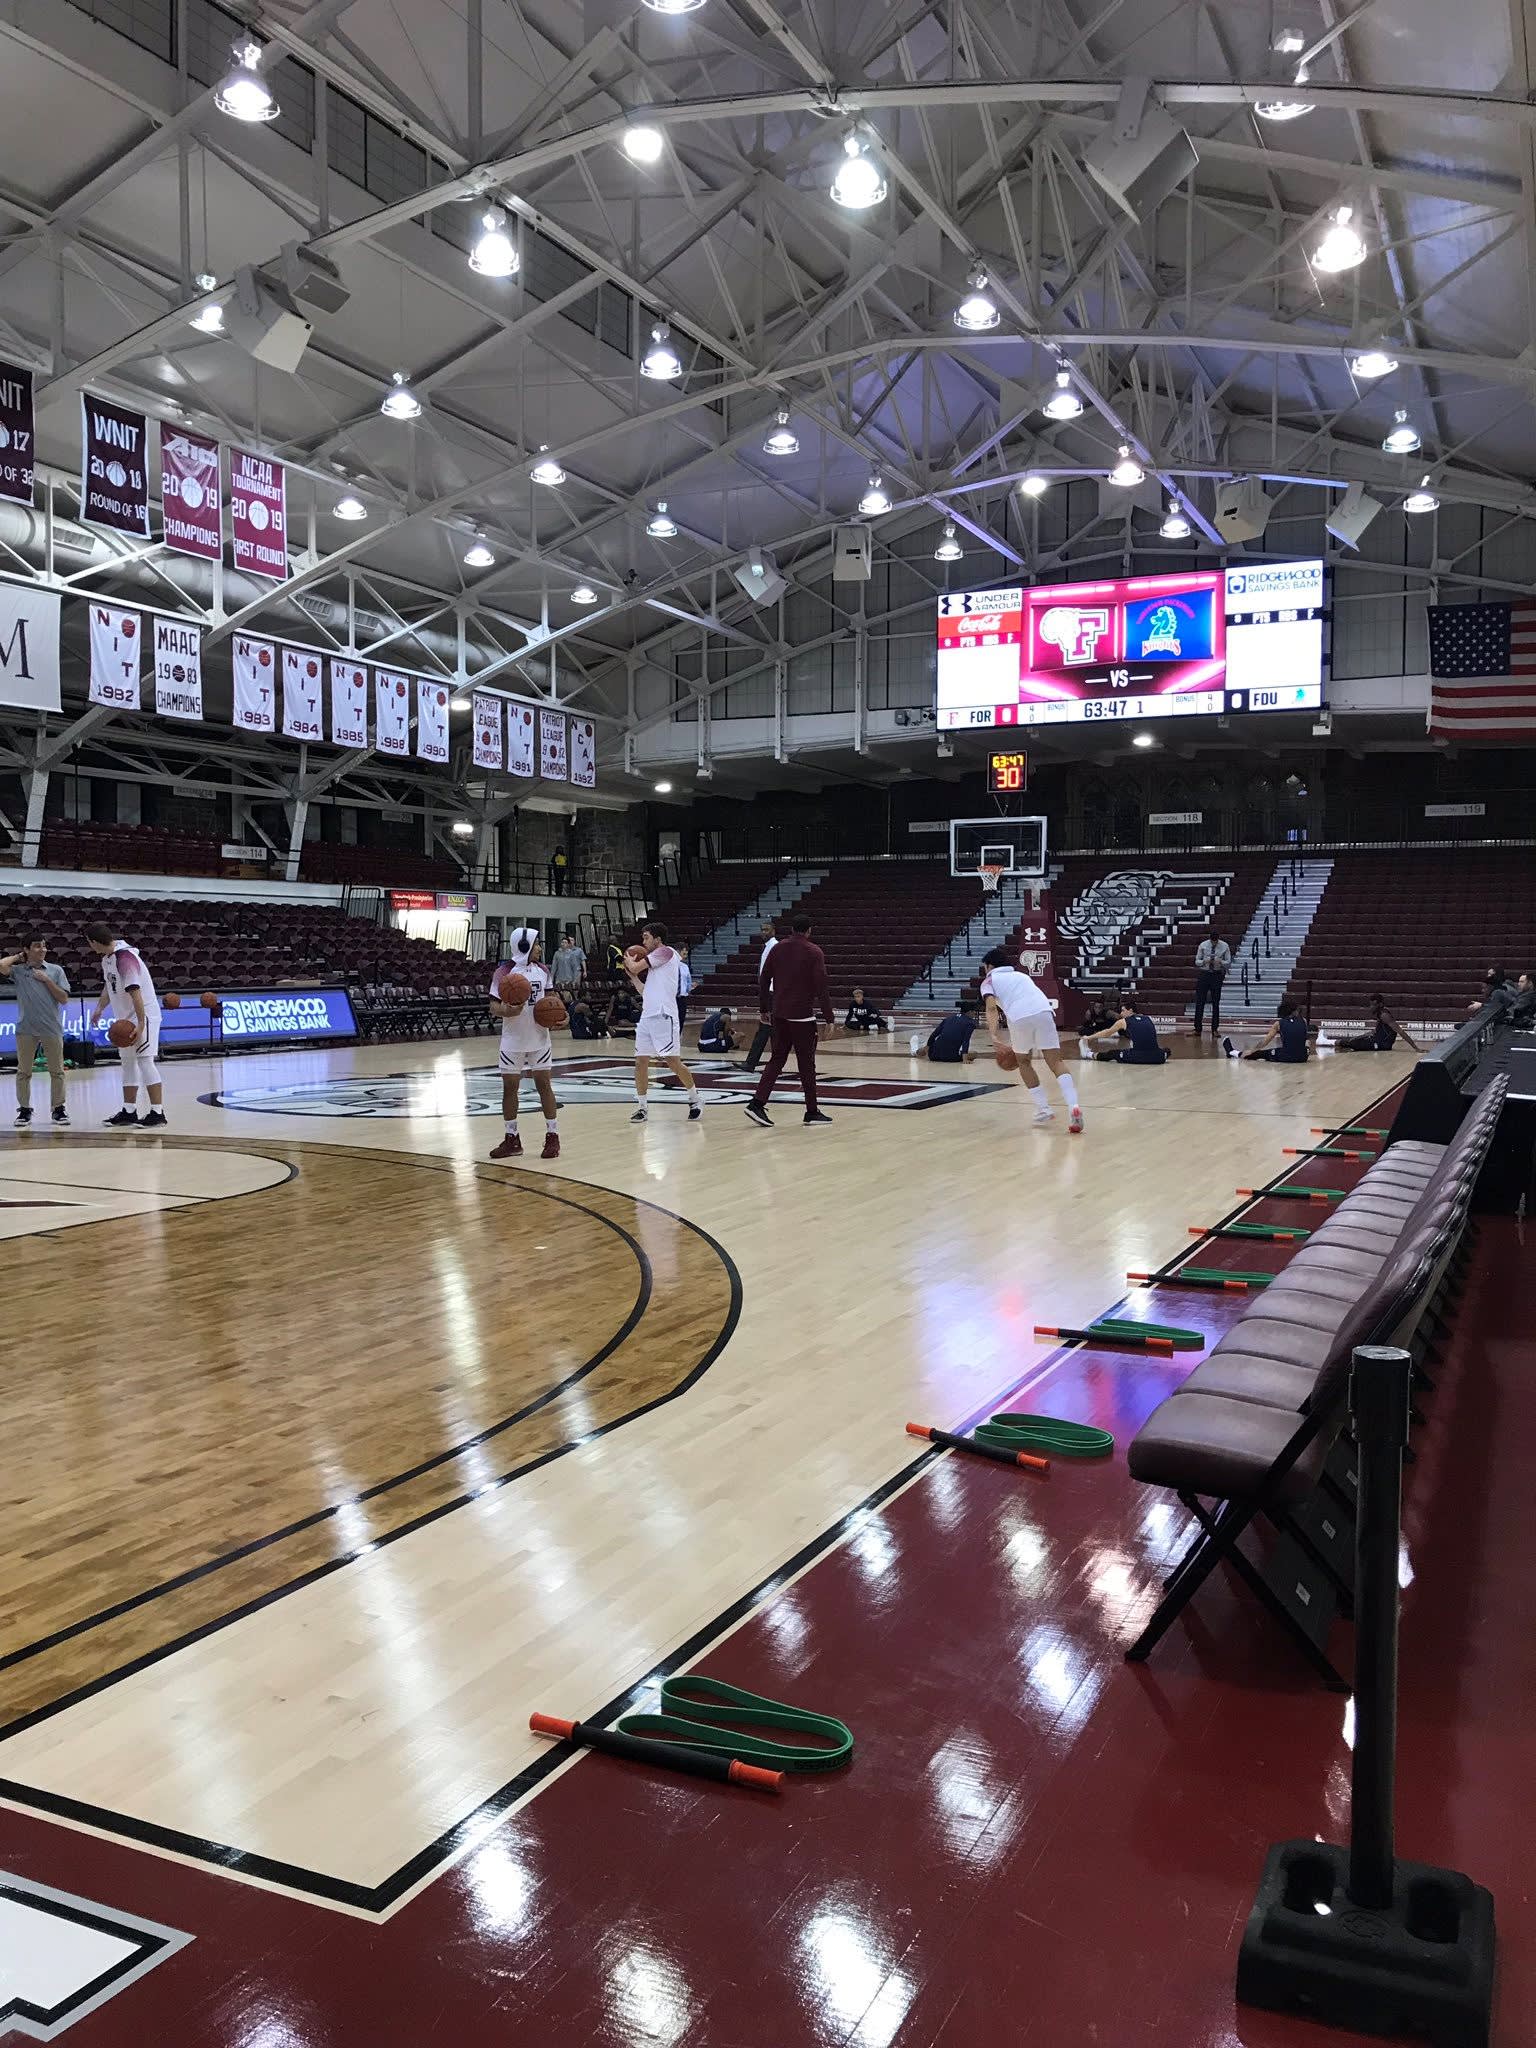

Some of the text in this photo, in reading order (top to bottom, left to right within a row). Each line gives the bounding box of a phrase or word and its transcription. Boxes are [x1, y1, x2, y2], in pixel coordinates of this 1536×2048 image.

[13, 430, 30, 451] 17
[93, 412, 139, 452] WNIT
[4, 465, 33, 487] OF 32
[91, 455, 141, 490] 20 18
[242, 455, 273, 486] NCAA
[162, 472, 217, 510] 20 19
[231, 473, 281, 502] TOURNAMENT
[90, 492, 147, 520] ROUND OF 16
[231, 497, 283, 531] 20 19
[163, 517, 219, 548] CHAMPIONS
[233, 538, 284, 567] FIRST ROUND
[1248, 569, 1321, 584] RIDGEWOOD
[1249, 580, 1320, 592] SAVINGS BANK
[975, 602, 1021, 611] ARMOUR
[976, 593, 1019, 603] UNDER
[158, 625, 197, 656] MAAC
[158, 663, 197, 684] 19 83
[1110, 669, 1129, 687] VS
[97, 684, 134, 702] 1982
[1175, 695, 1195, 703] BONUS
[1231, 692, 1277, 709] 0 FDU
[157, 690, 201, 714] CHAMPIONS
[1047, 703, 1065, 711] BONUS
[1084, 701, 1143, 718] 63:47 1
[240, 710, 270, 725] 1983
[542, 713, 563, 728] PATRIOT
[970, 708, 1011, 723] FOR 0
[290, 720, 319, 734] 1984
[336, 728, 364, 742] 1985
[542, 728, 563, 742] LEAGUE
[511, 760, 531, 772] 1991
[992, 754, 1024, 768] 63:47
[574, 773, 594, 784] 1992
[997, 767, 1019, 788] 30
[1184, 813, 1199, 822] 118
[1463, 804, 1481, 815] 119
[251, 849, 263, 858] 114
[241, 998, 327, 1018] RIDGEWOOD
[247, 1014, 331, 1034] SAVINGS BANK
